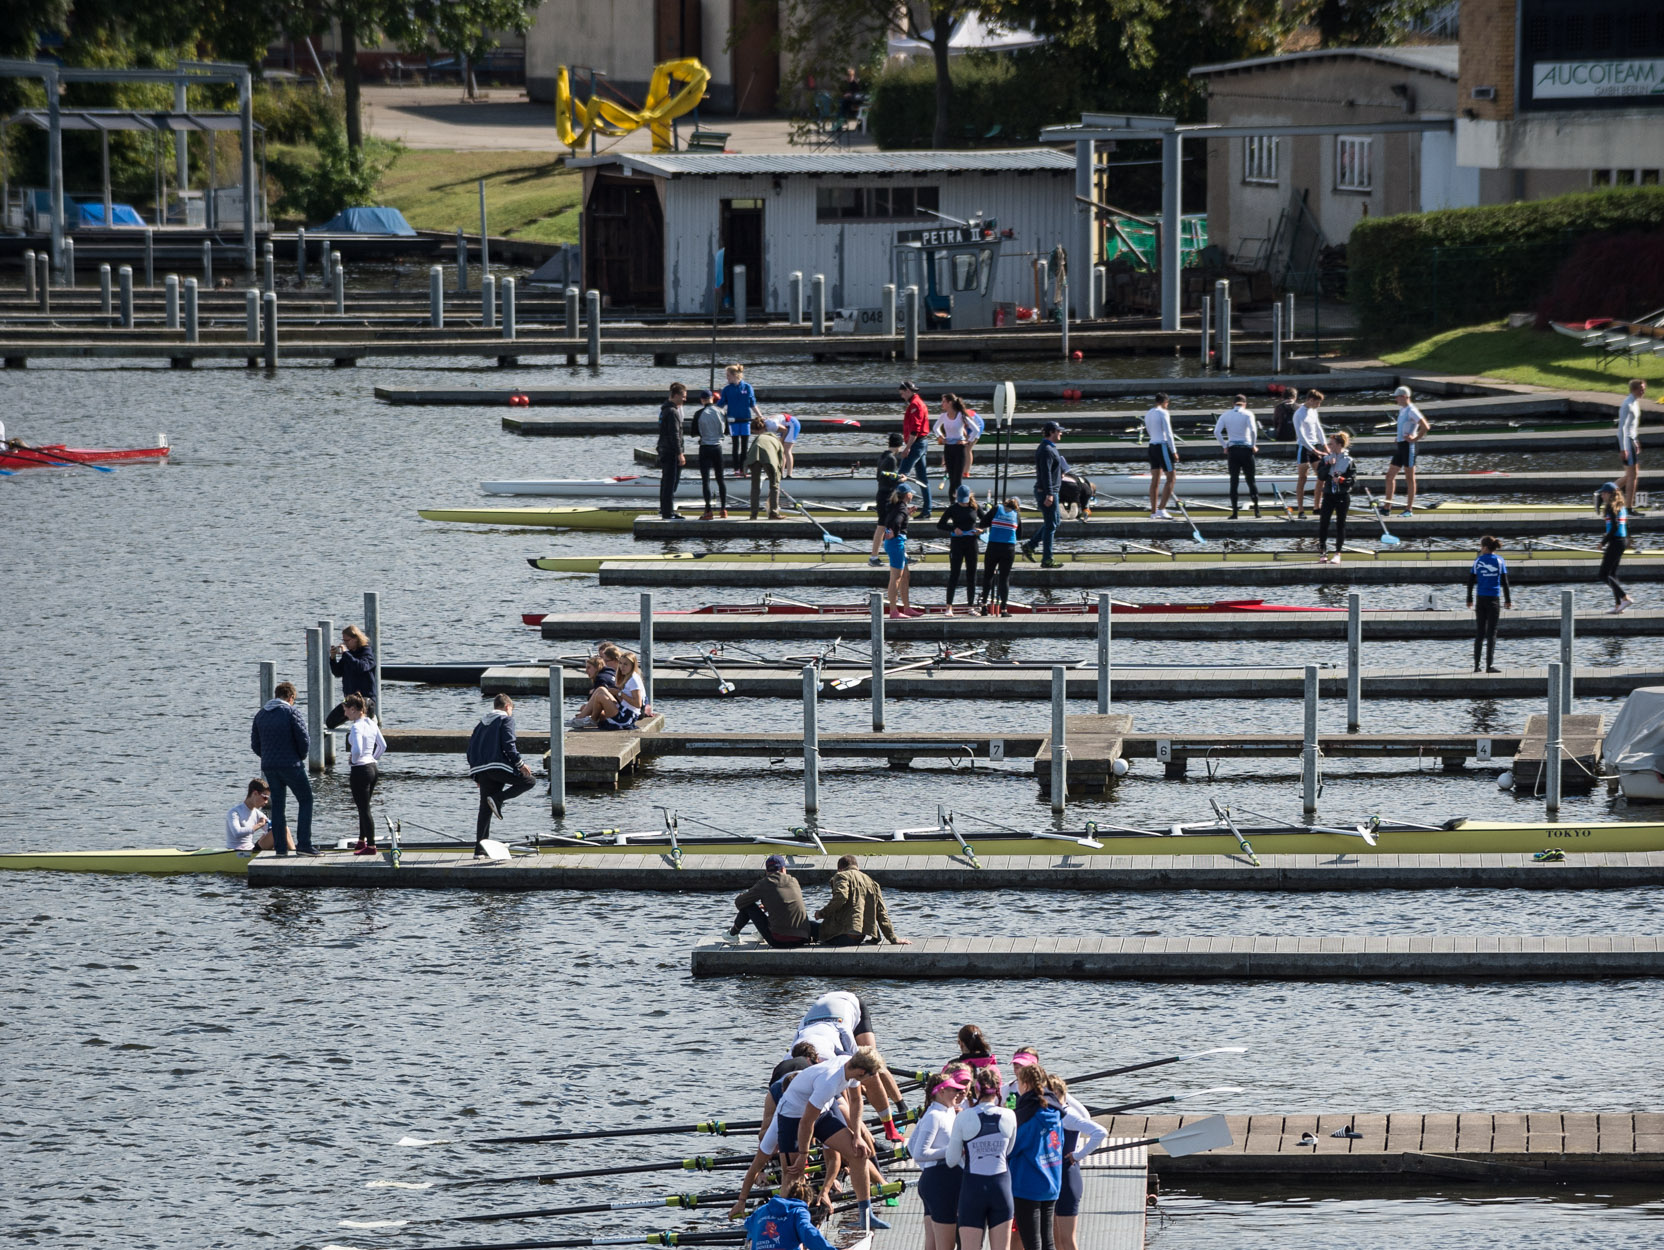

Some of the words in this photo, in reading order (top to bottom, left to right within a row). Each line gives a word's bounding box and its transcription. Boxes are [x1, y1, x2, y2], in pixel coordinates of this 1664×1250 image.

[1537, 63, 1656, 87] AUCOTEAM
[922, 229, 963, 245] PETRA
[993, 745, 1000, 756] 7
[1160, 745, 1168, 756] 6
[1479, 745, 1488, 756] 4
[1545, 829, 1592, 838] TOKYO
